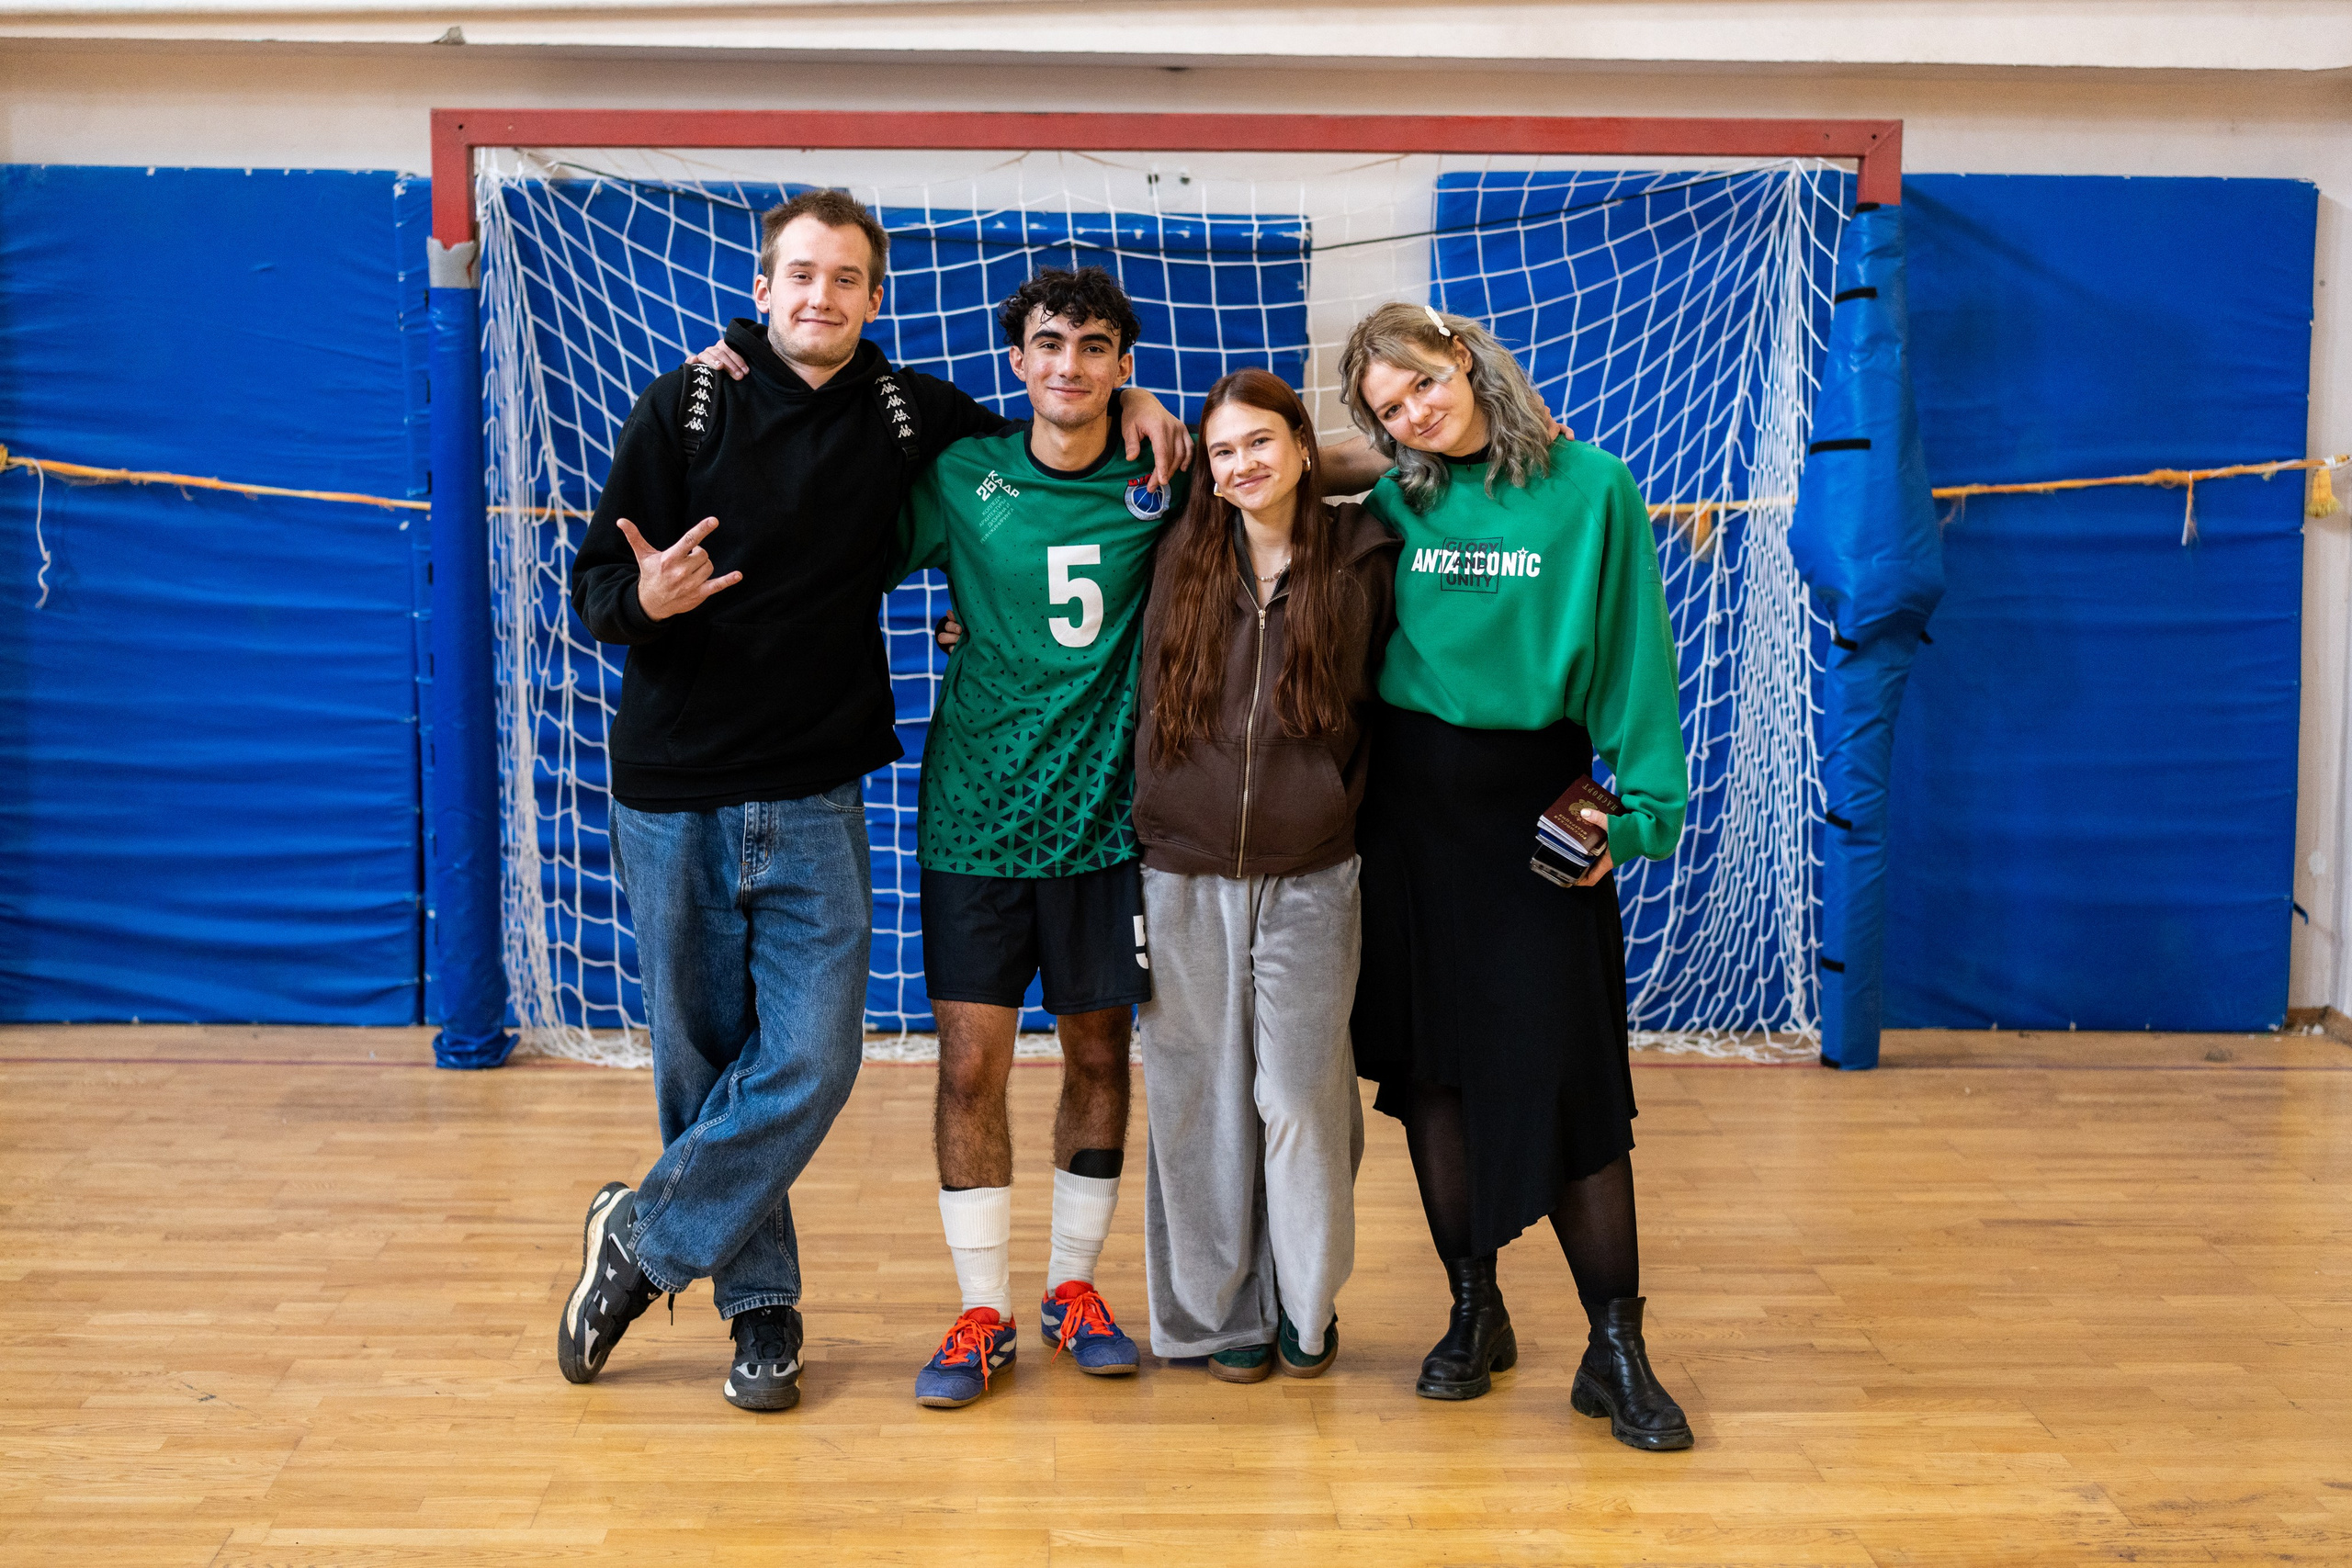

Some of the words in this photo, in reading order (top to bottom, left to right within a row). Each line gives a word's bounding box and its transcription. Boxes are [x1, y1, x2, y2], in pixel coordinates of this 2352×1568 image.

[976, 477, 998, 502] 26
[988, 469, 1020, 498] КАДР
[1445, 541, 1498, 554] GLORY
[1453, 557, 1488, 570] AND
[1446, 574, 1493, 587] UNITY
[1047, 544, 1104, 648] 5
[1581, 783, 1619, 812] ПАСПОРТ
